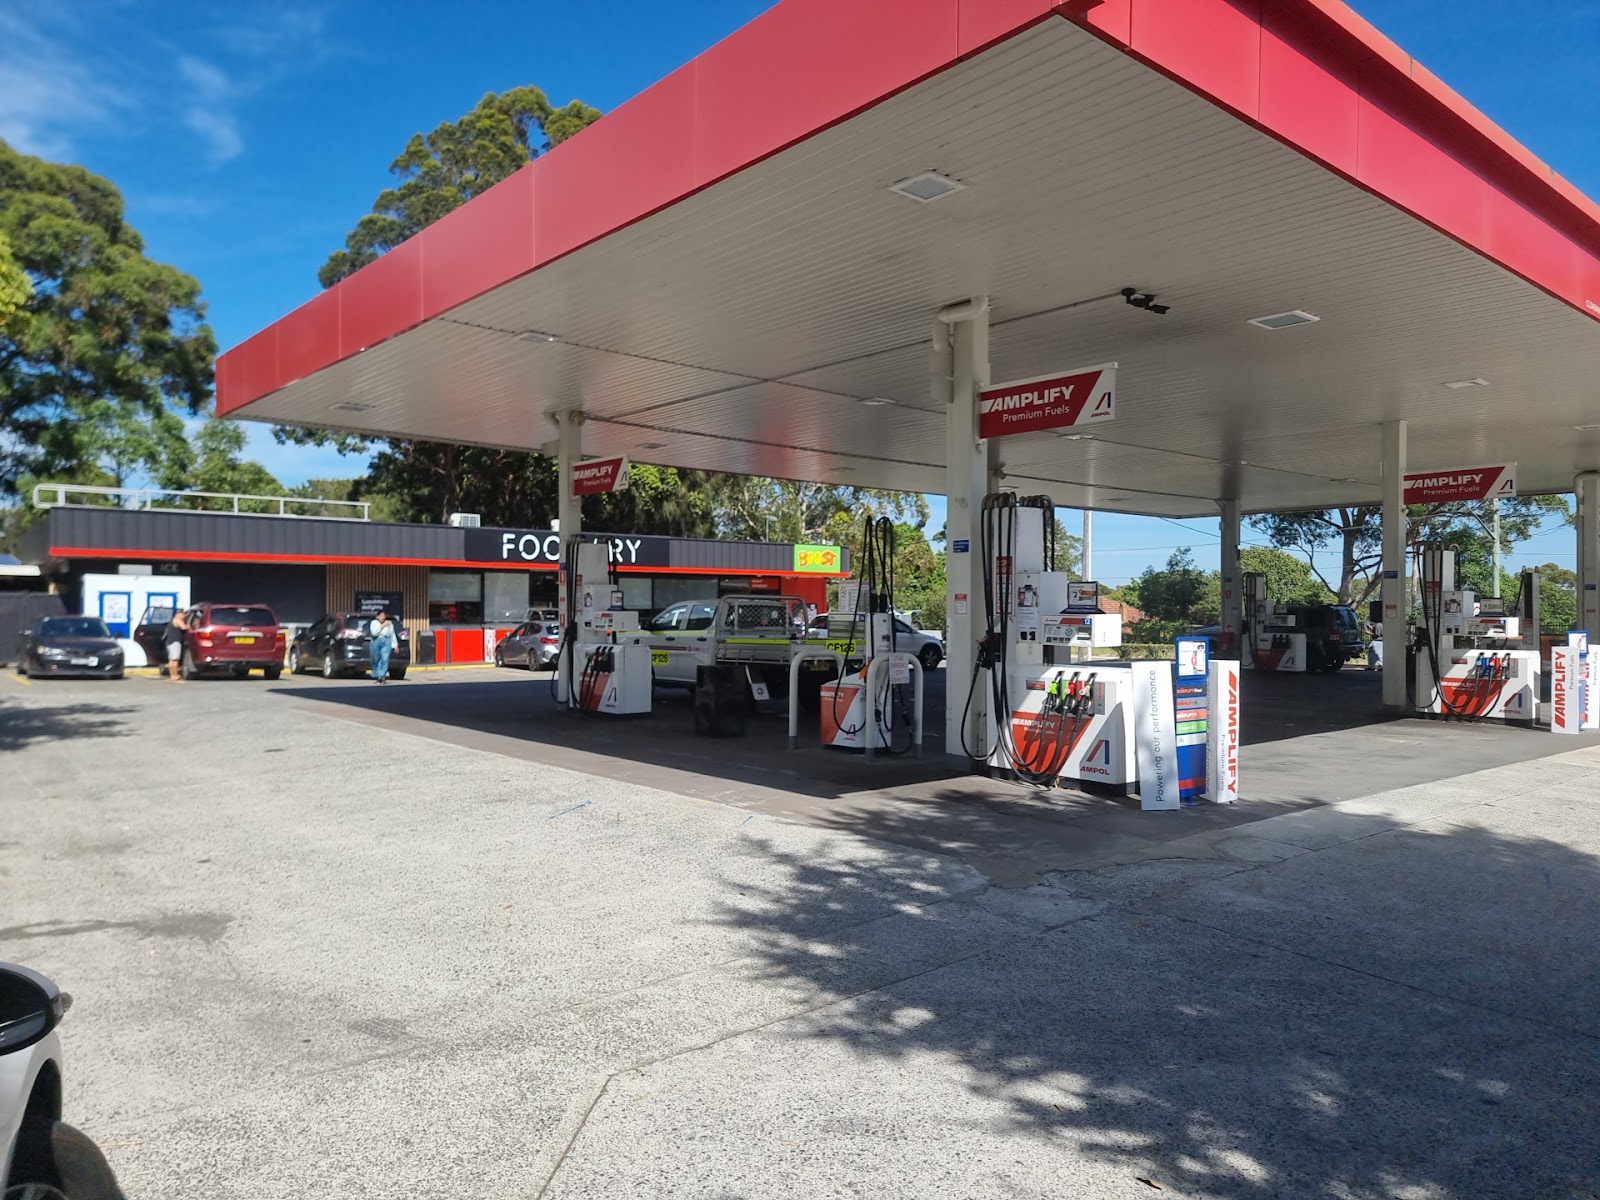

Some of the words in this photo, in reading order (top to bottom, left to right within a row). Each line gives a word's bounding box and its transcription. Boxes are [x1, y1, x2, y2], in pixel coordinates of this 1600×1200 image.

[990, 384, 1075, 412] AMPLIFY
[1002, 411, 1043, 423] Premium
[1045, 405, 1070, 416] Fuels
[578, 465, 613, 480] AMPLIFY
[1412, 474, 1483, 489] AMPLIFY
[1423, 488, 1458, 496] Premium
[1459, 485, 1480, 493] Fuels
[502, 533, 642, 564] FOORY
[798, 550, 838, 567] BOOST
[1554, 651, 1566, 718] AMPLIFY
[1149, 669, 1162, 733] performance
[1153, 736, 1161, 753] our
[1227, 690, 1238, 795] AMPLIFY
[1080, 765, 1110, 776] AMPOL
[1152, 755, 1164, 802] Powering
